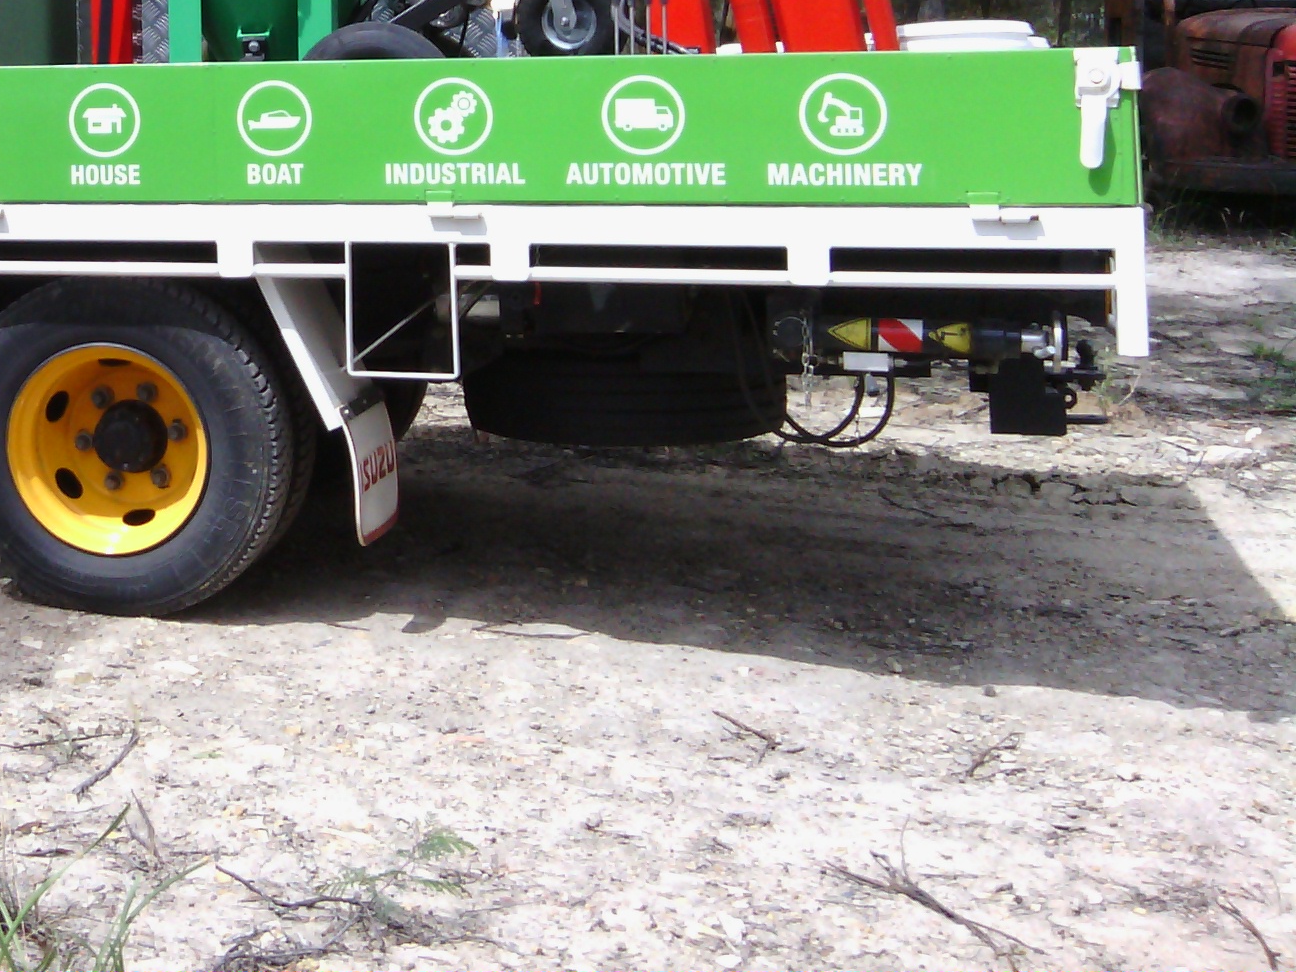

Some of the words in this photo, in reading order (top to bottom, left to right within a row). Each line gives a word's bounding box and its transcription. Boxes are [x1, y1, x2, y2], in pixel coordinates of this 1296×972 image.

[70, 164, 141, 186] HOUSE
[246, 163, 304, 185] BOAT
[385, 162, 526, 185] INDUSTRIAL
[566, 162, 726, 186] AUTOMOTIVE
[767, 162, 923, 187] MACHINERY
